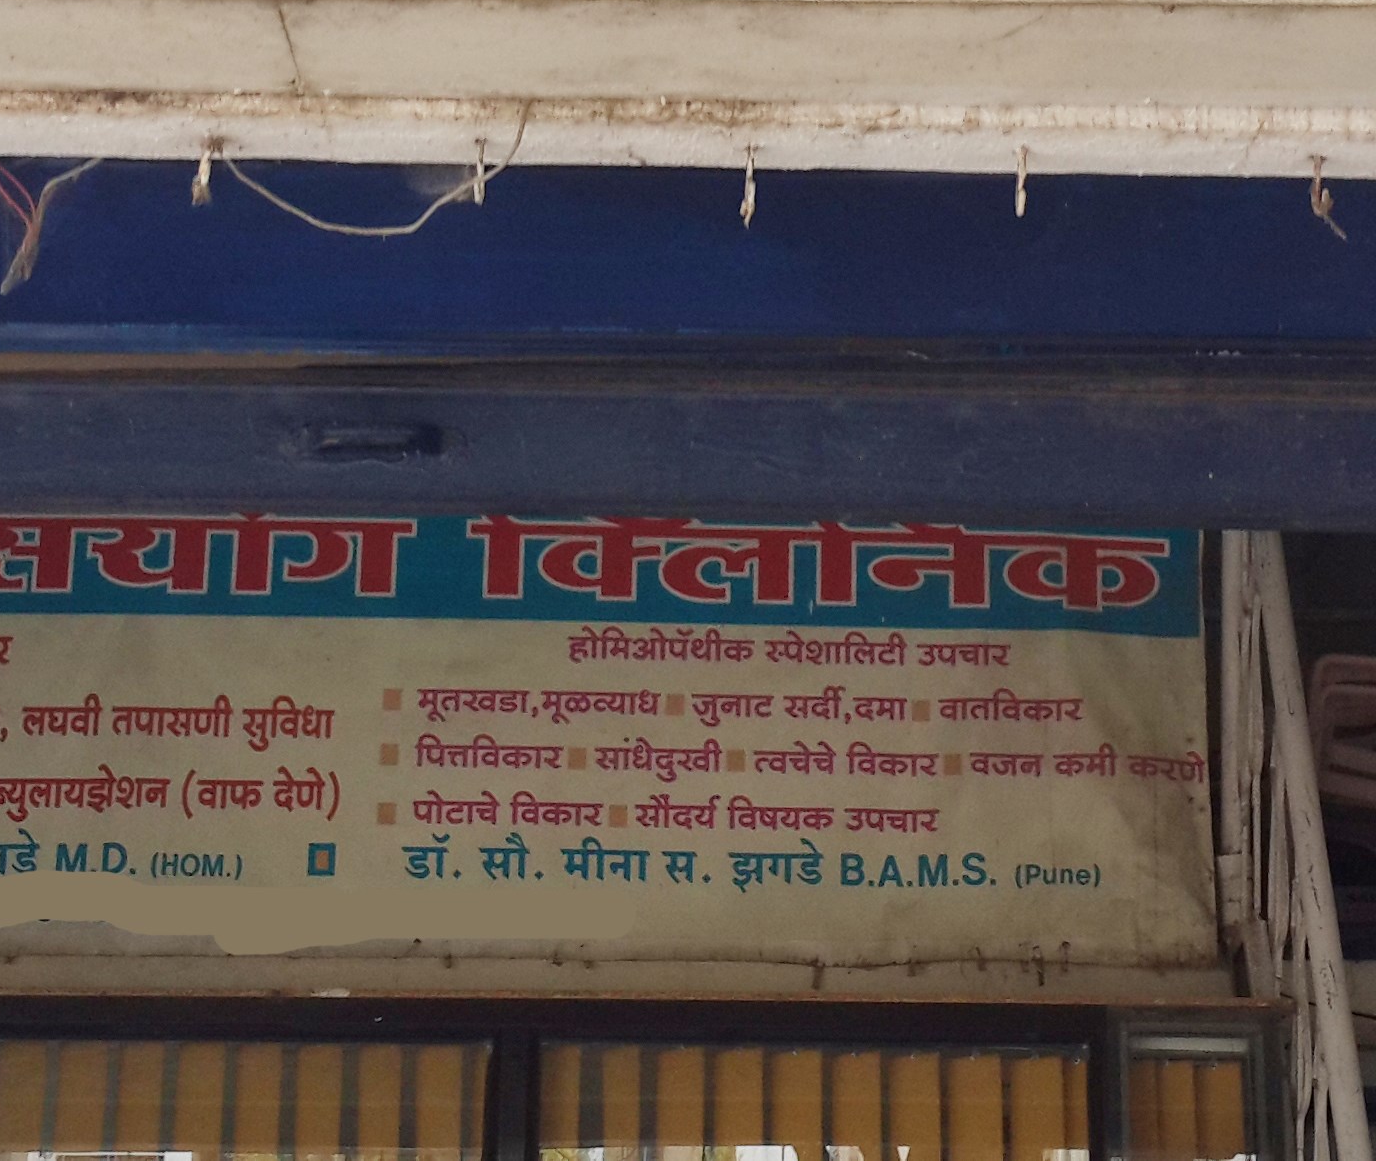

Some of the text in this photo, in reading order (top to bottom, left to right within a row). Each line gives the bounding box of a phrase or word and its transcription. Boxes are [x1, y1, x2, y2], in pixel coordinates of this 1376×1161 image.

[568, 627, 755, 664] होमिओपॅथीक
[917, 642, 1011, 668] उपचार
[22, 693, 101, 737] लघवी
[112, 695, 231, 738] तपासणी
[242, 694, 335, 751] सुविधा
[692, 693, 774, 727] जुनाट
[938, 688, 1083, 722] वातविकार
[415, 734, 1204, 783] पित्तविकार सांधेदुखी त्वचेचे विकार वजन कमी करणे
[182, 769, 264, 819] (वाफ
[274, 766, 341, 821] देणे)
[412, 790, 500, 826] पोटाचे
[510, 791, 603, 827] विकार
[728, 795, 833, 831] विषयक
[845, 808, 939, 833] उपचार
[55, 842, 136, 876] M.D.
[150, 851, 244, 880] (HOM.)
[402, 832, 1101, 893] डॉ. सौ. मीना स. झगडे B.A.M.S. (Pune)
